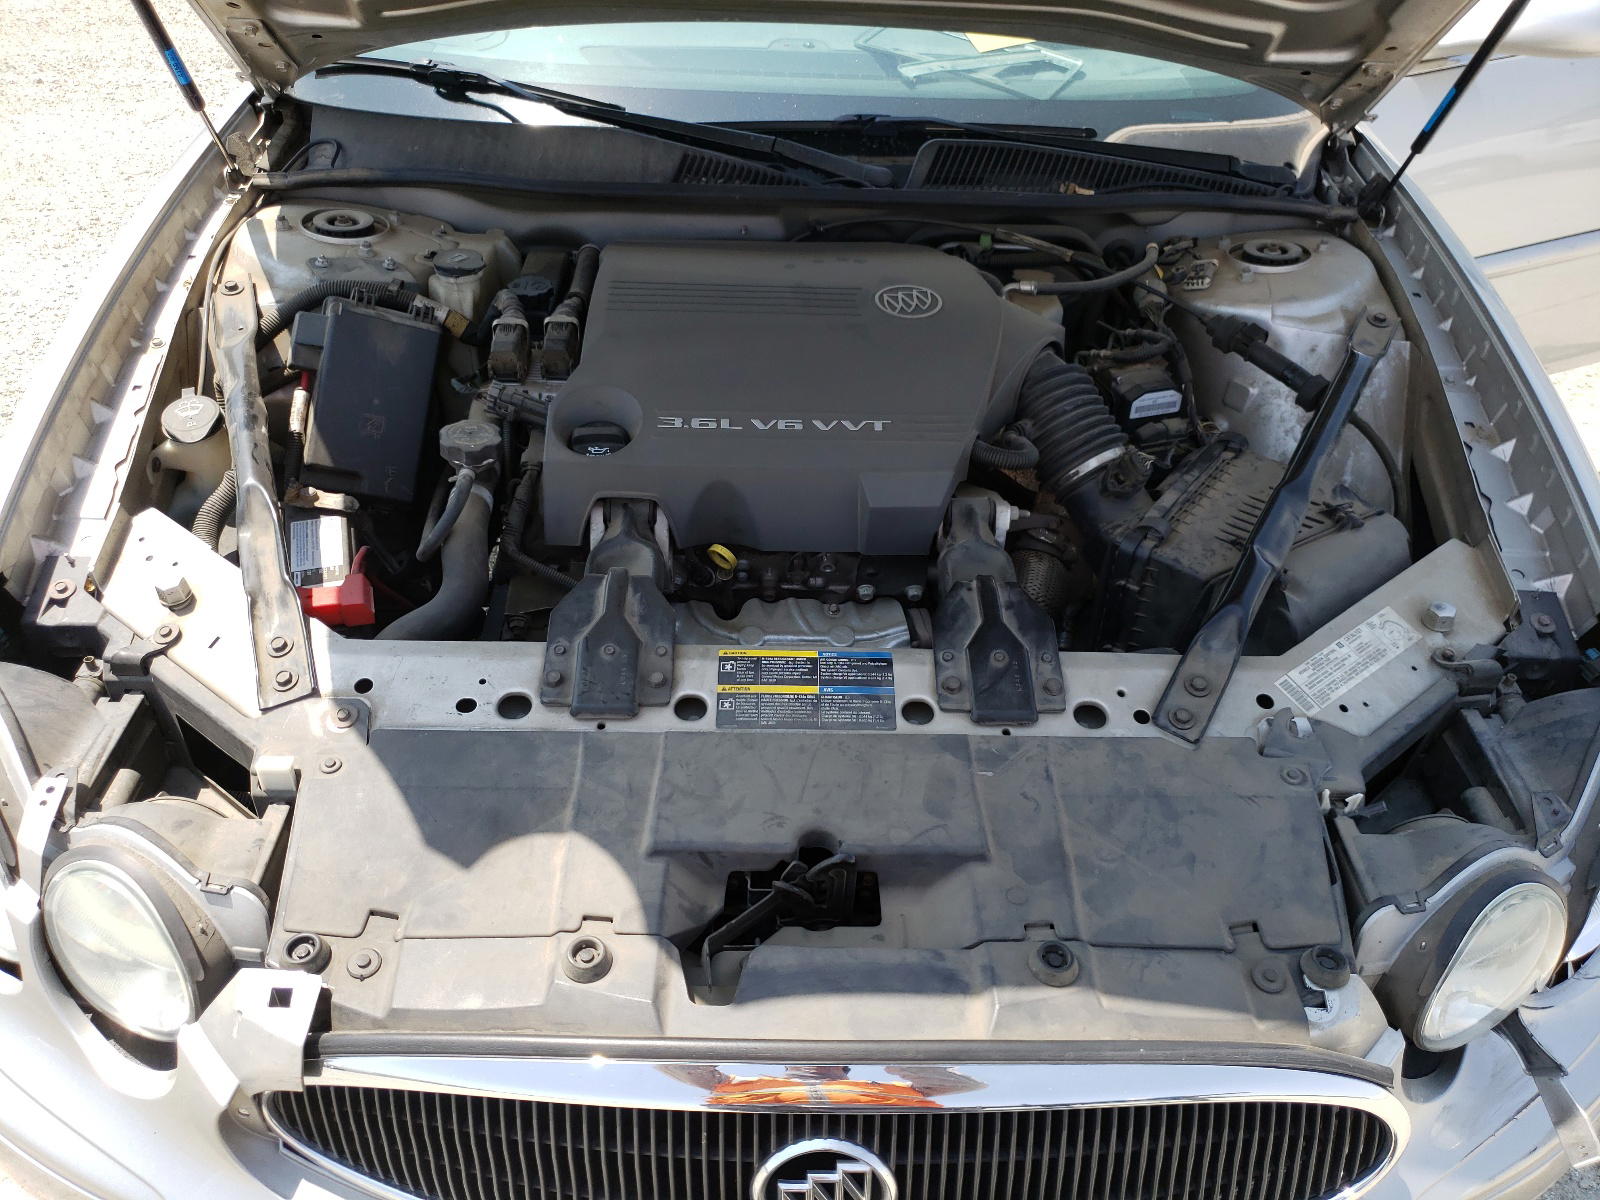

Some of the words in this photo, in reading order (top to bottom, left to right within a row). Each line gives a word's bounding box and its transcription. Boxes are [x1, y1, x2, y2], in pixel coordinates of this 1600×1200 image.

[656, 416, 743, 430] 3.6L
[750, 418, 804, 431] V6
[811, 419, 892, 432] VVT
